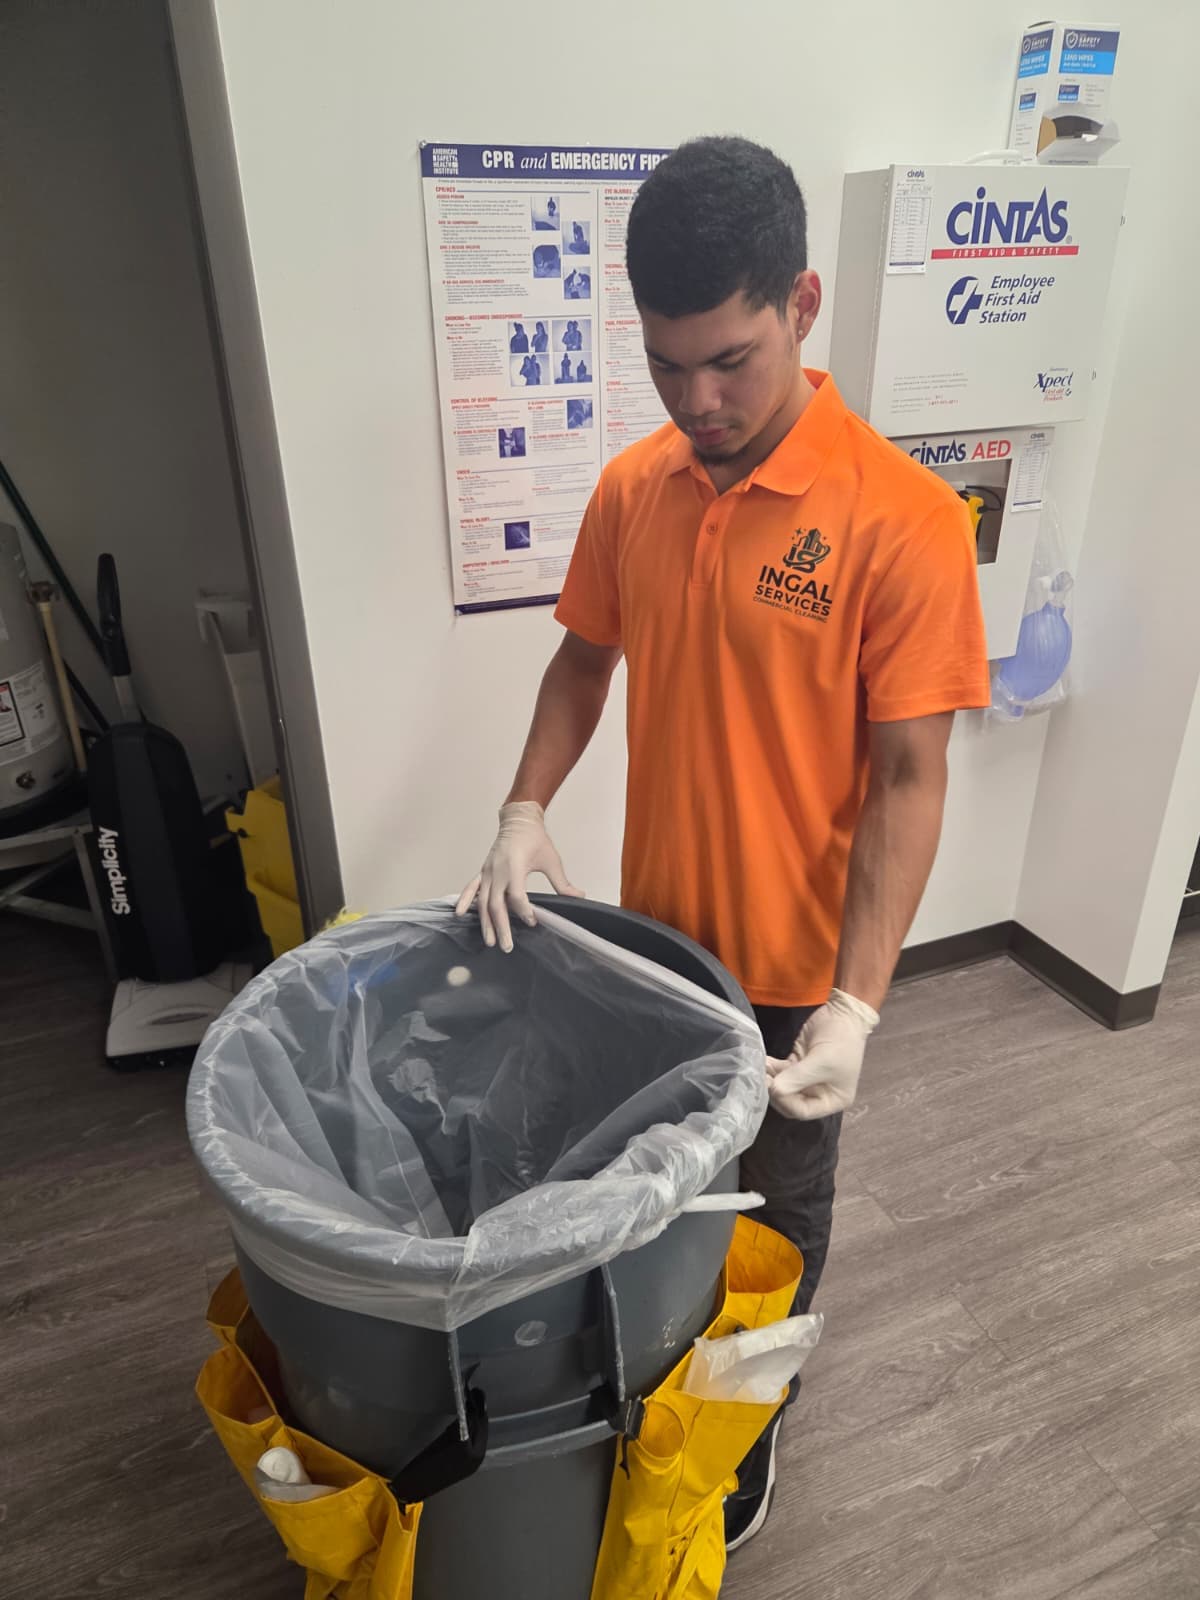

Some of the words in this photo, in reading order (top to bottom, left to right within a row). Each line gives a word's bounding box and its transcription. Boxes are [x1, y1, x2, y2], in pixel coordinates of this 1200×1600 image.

[482, 150, 514, 169] CPR
[520, 152, 547, 169] and
[551, 152, 636, 170] EMERGENCY
[640, 154, 669, 170] FIR
[946, 185, 1069, 245] CINTAS
[952, 249, 982, 257] FIRST
[987, 249, 1006, 257] AID
[1023, 247, 1060, 256] SAFETY
[991, 274, 1055, 291] Employee
[985, 292, 1014, 307] First
[1017, 289, 1041, 305] Aid
[979, 310, 1026, 324] Station
[1033, 371, 1073, 393] Xpect
[971, 440, 1011, 460] AED
[759, 565, 832, 604] INGAL
[755, 584, 831, 616] SERVICES
[99, 826, 131, 915] Simplicity
